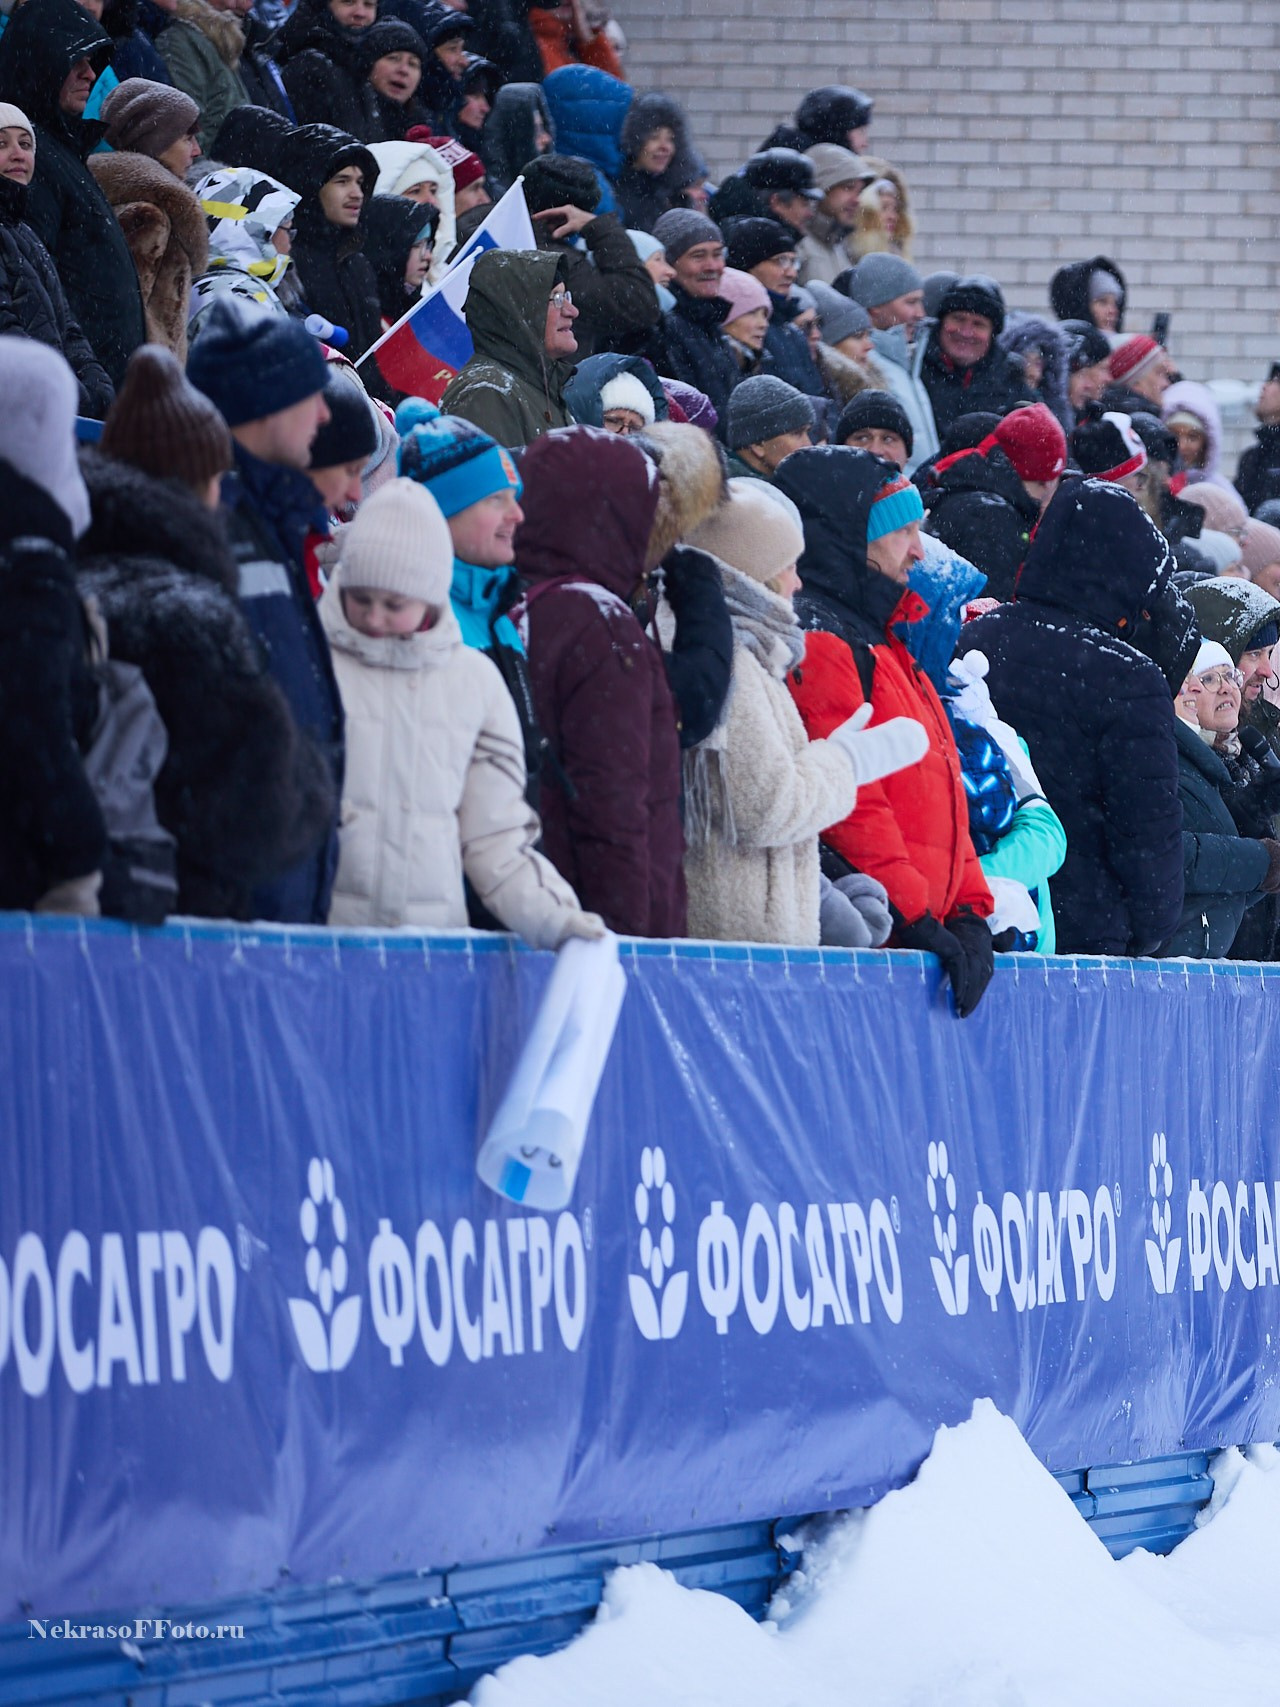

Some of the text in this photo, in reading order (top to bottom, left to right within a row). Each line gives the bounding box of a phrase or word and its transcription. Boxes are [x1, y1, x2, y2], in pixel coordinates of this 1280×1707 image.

[0, 1225, 237, 1396] ОСАГРО
[368, 1210, 587, 1367] ФОСАГРО
[697, 1198, 903, 1336] ФОСАГРО
